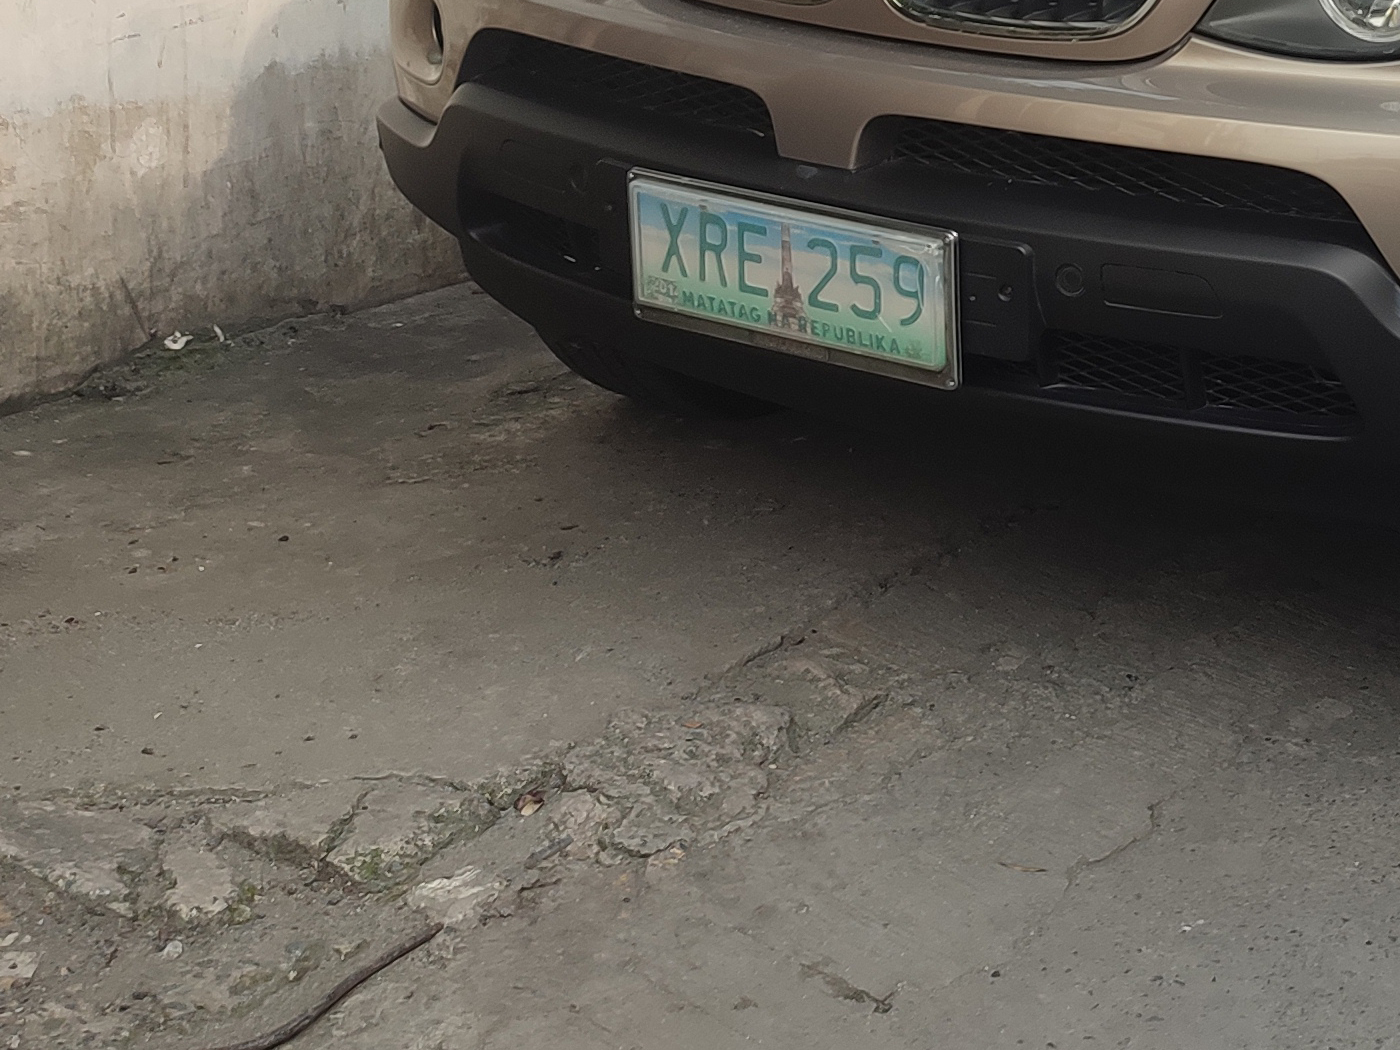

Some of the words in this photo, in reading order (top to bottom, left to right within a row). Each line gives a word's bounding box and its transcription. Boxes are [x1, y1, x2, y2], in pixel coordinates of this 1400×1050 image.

[660, 202, 769, 298] XRE
[807, 237, 923, 327] 259
[682, 291, 761, 323] MATATAG
[799, 316, 900, 354] REPUBLIKA
